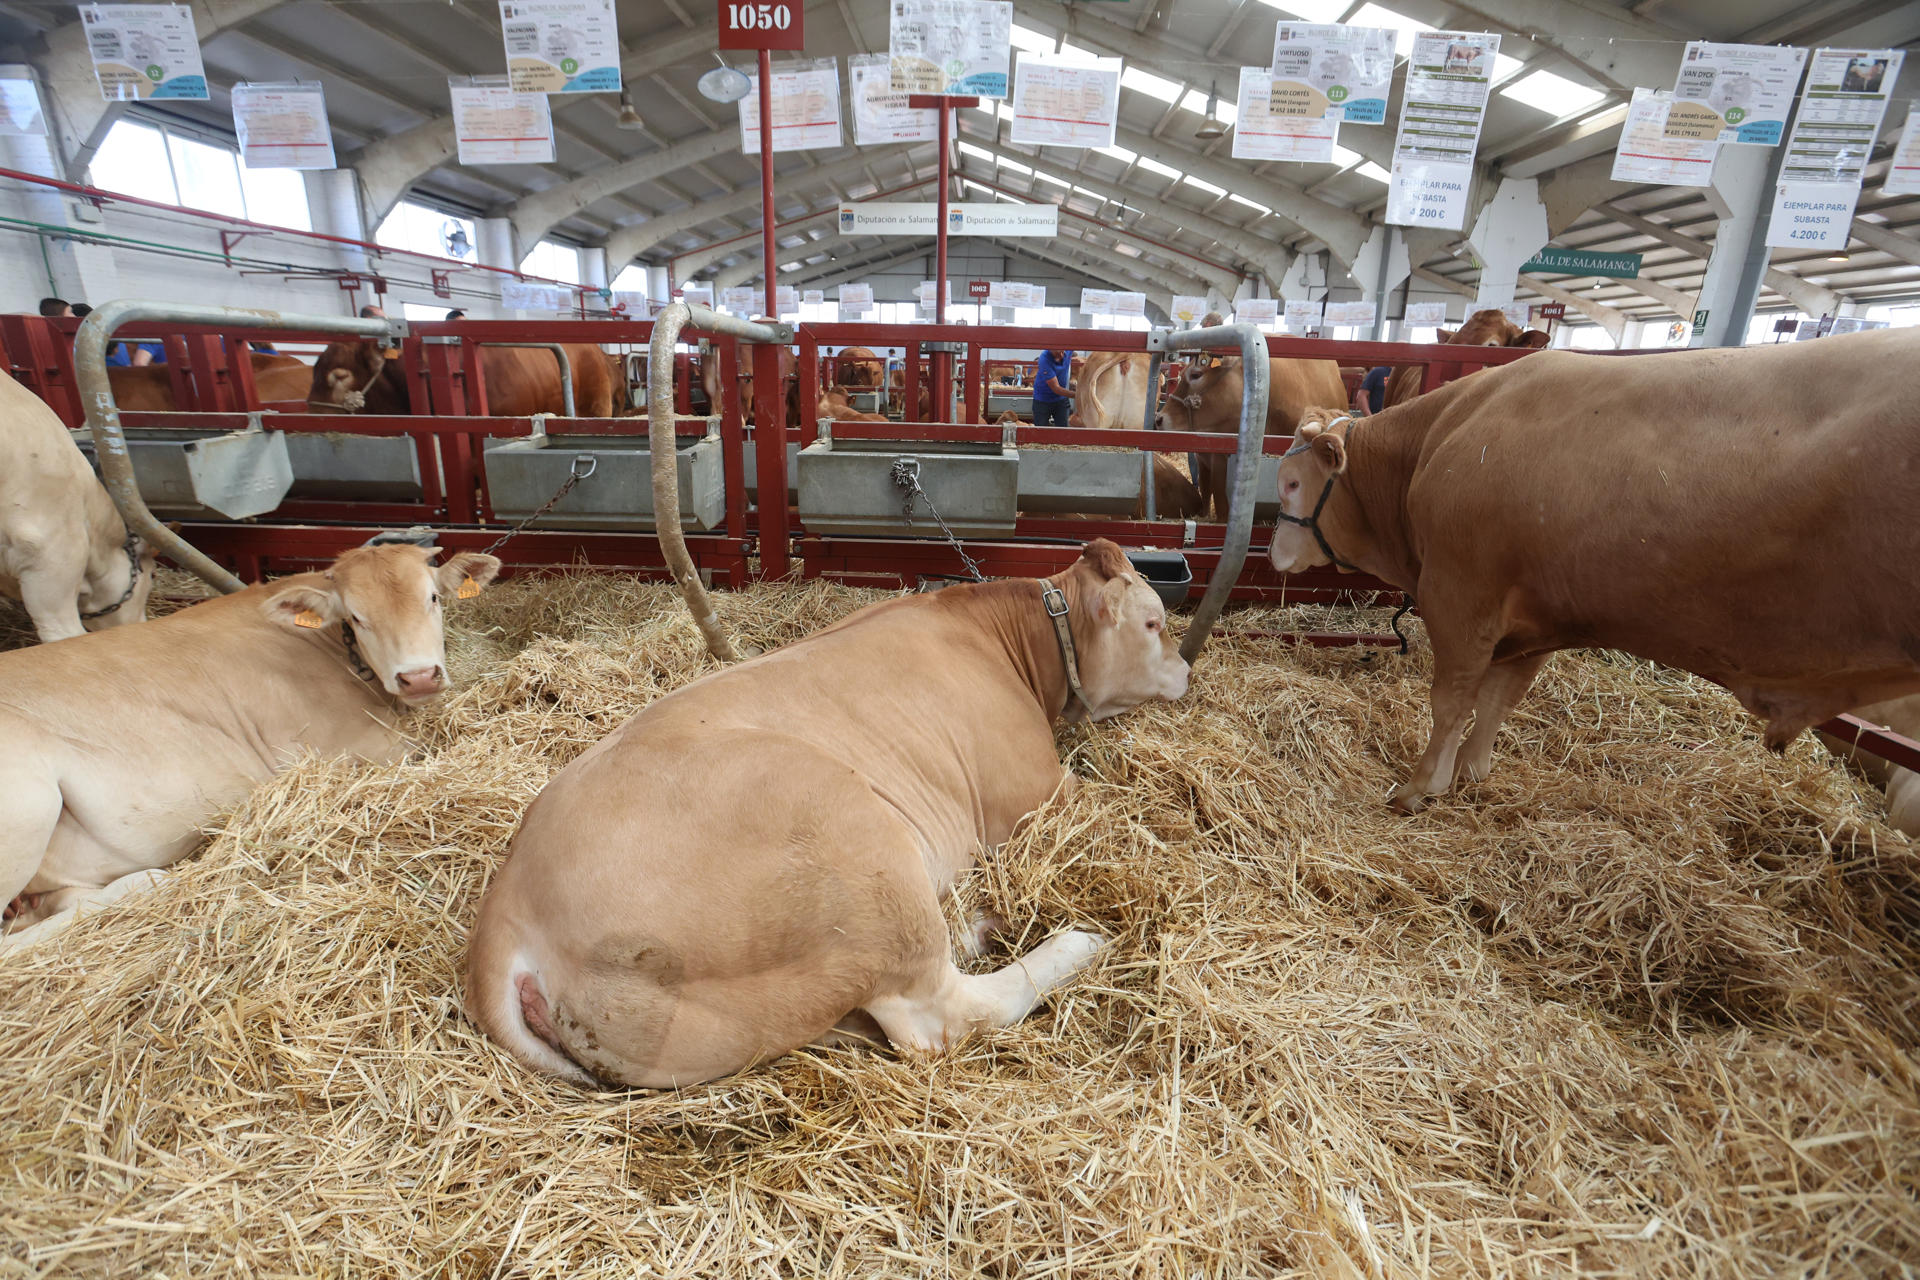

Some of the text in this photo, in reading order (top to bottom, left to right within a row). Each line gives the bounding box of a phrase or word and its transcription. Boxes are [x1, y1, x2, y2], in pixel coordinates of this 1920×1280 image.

[728, 4, 791, 30] 1050
[1280, 49, 1309, 57] VIRTUOSO
[566, 62, 574, 70] 17
[1683, 70, 1715, 79] VAN DYCK
[1727, 111, 1741, 120] 114
[1400, 179, 1462, 191] EPLAR PARA
[1783, 202, 1847, 211] EJEMPLAR PARA
[1438, 209, 1446, 219] €
[857, 215, 897, 225] Diputación
[908, 215, 938, 224] Salaman
[1018, 216, 1056, 225] Salamanca
[1794, 215, 1830, 224] SUBASTA
[1790, 230, 1827, 240] 4.200 €
[1525, 252, 1636, 272] URAL DE SALAMANCA
[971, 284, 987, 292] 1062
